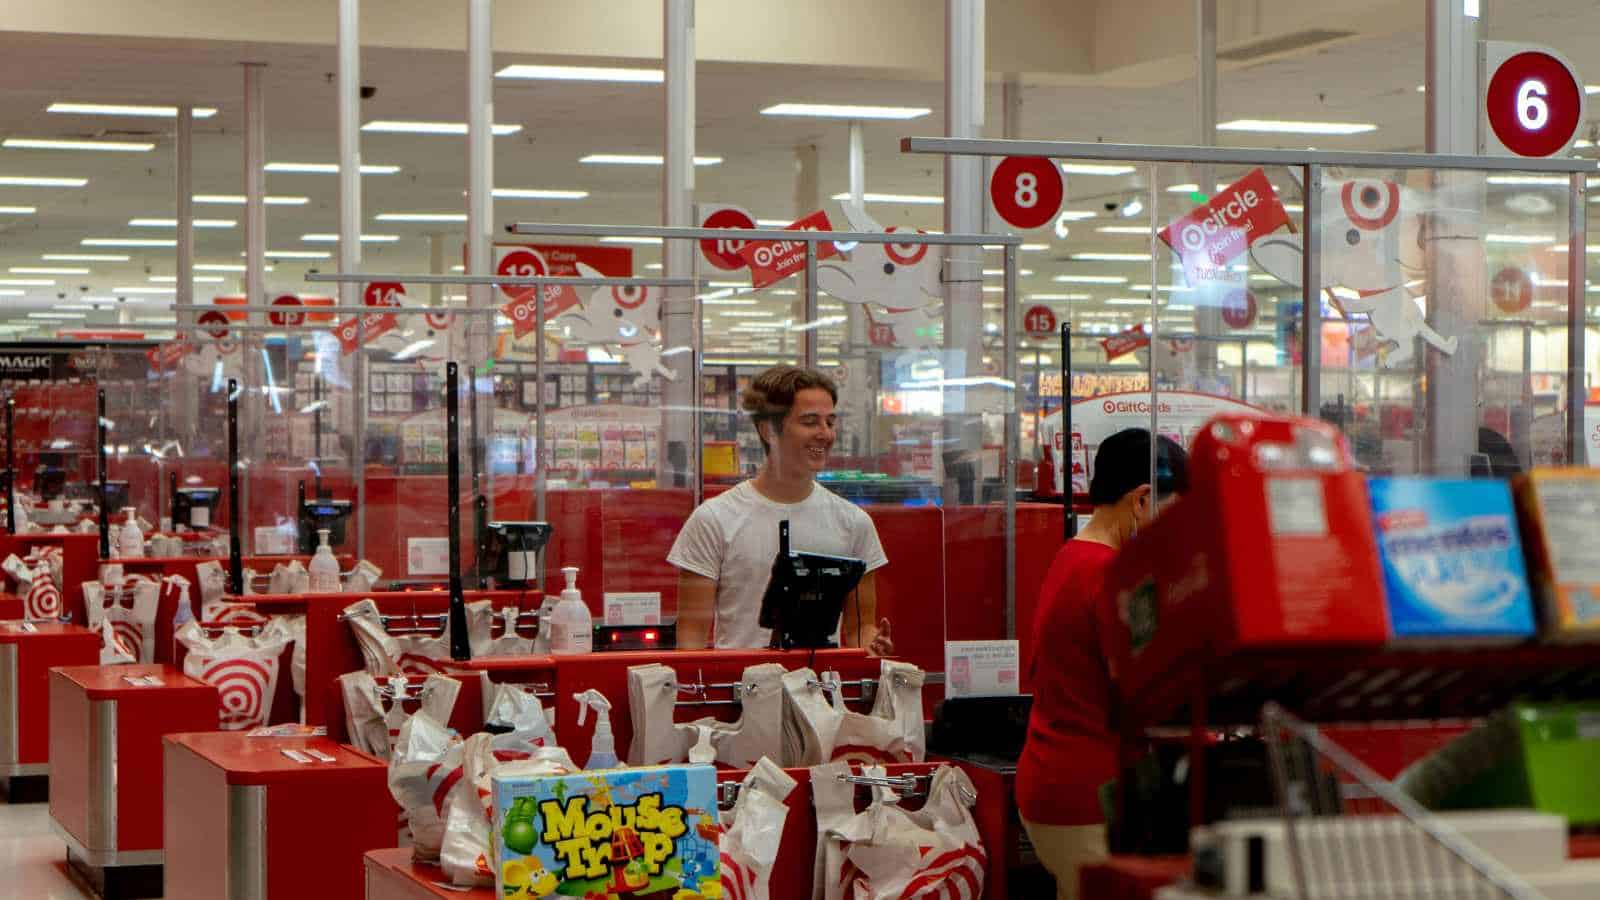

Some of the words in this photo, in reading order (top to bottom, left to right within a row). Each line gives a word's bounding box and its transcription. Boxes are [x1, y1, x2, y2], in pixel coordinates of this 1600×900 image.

[1517, 80, 1548, 130] 6
[1015, 172, 1038, 208] 8
[1202, 190, 1258, 235] circle
[1029, 313, 1050, 329] 15
[0, 355, 51, 369] MAGIC
[539, 792, 688, 843] Mouse
